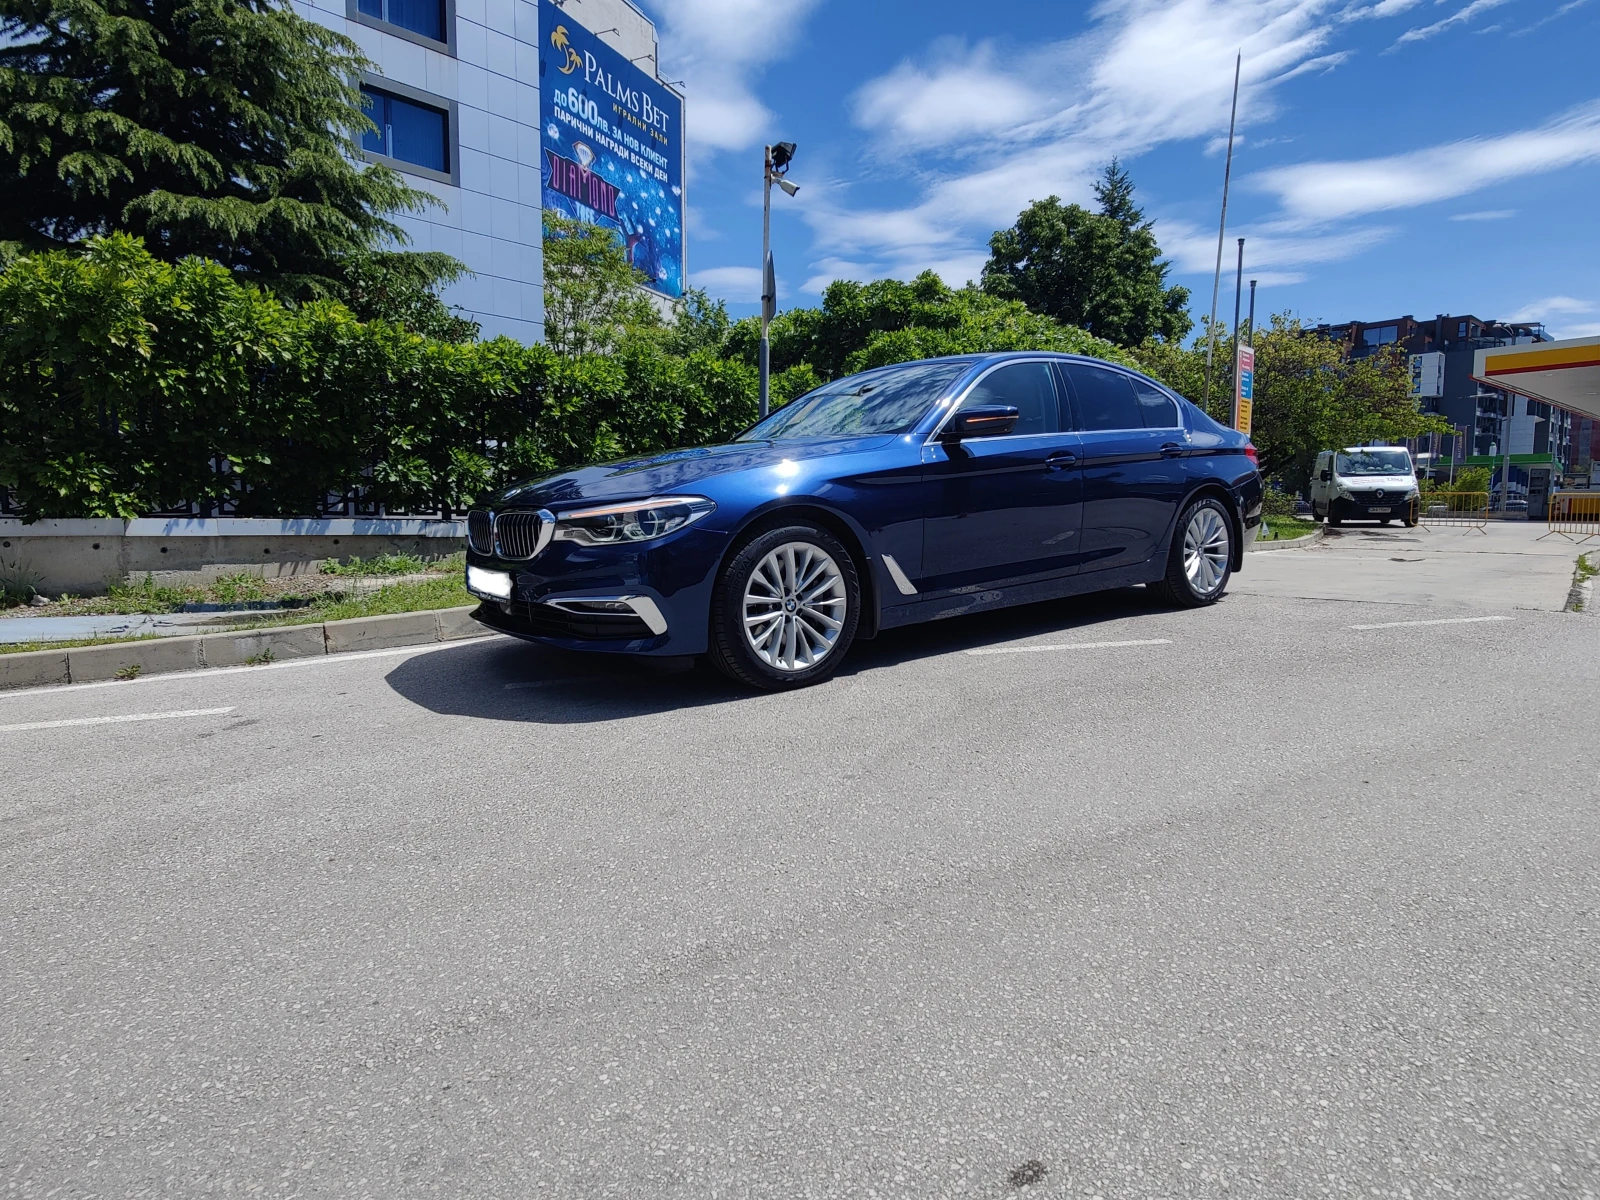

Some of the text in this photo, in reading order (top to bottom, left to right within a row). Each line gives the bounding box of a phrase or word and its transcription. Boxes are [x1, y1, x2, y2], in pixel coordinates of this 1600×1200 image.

[583, 49, 669, 133] PALMS BET
[554, 106, 668, 183] ПАРИЧНИ НАГРАДИ ВСЕКИ ДЕН
[612, 102, 668, 146] ИГРАЛНИ ЗАЛИ
[612, 125, 623, 143] ЗА
[623, 133, 639, 153] НОВ
[640, 145, 668, 170] КЛИЕНТ
[553, 155, 615, 217] DIAMOND
